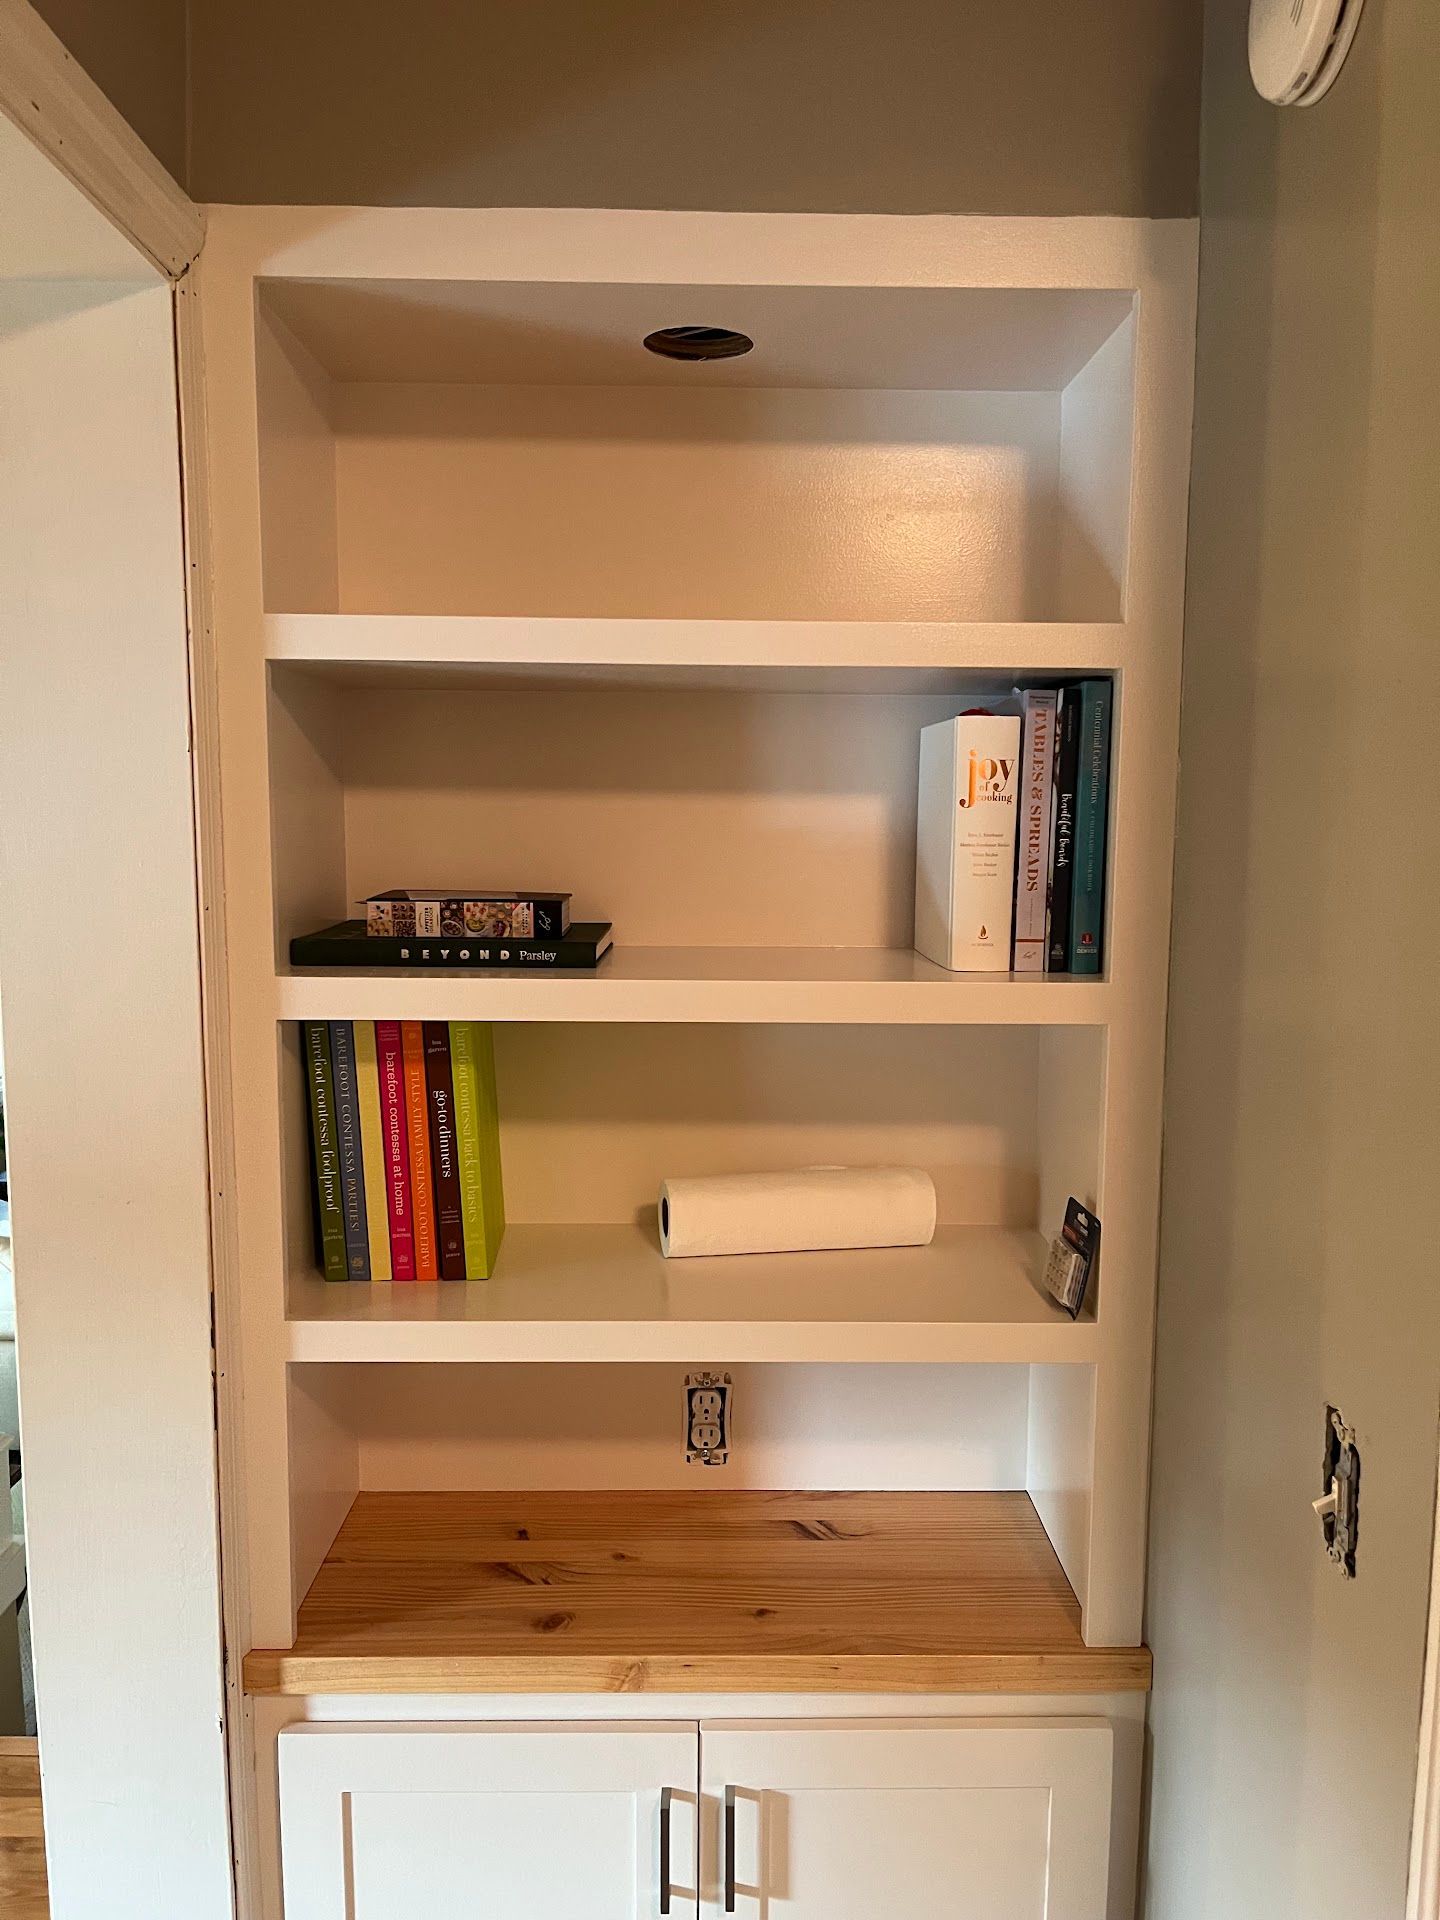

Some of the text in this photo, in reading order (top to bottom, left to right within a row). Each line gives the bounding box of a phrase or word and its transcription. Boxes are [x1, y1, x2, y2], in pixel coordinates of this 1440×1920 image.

[1032, 708, 1049, 783] TABLES
[1092, 700, 1104, 749] Centennial
[959, 749, 1016, 809] joy
[977, 791, 1013, 805] cooking
[979, 781, 991, 791] of
[1031, 787, 1043, 801] &
[1090, 749, 1102, 805] Celebrations
[1026, 804, 1042, 893] SPREADS
[1056, 793, 1072, 868] Beautiful Boards
[401, 949, 557, 963] BEYOND Parsley
[310, 1027, 327, 1084] barefoot
[335, 1028, 351, 1099] BAREFOOT
[385, 1052, 398, 1104] barefoot
[455, 1028, 469, 1082] barefoot
[410, 1070, 421, 1103] STYLE
[461, 1085, 473, 1137] contessa
[317, 1088, 330, 1147] contessa
[342, 1104, 355, 1174] CONTESSA
[389, 1107, 401, 1163] contessa
[412, 1105, 424, 1146] FAMILY
[433, 1090, 452, 1178] go-to dinners
[394, 1166, 402, 1179] at
[415, 1147, 427, 1206] CONTESSA
[465, 1139, 474, 1167] back
[467, 1169, 474, 1183] to
[319, 1150, 340, 1214] foolproof
[347, 1178, 360, 1233] PARTIES!
[394, 1182, 404, 1216] home
[468, 1185, 480, 1223] basics
[418, 1207, 430, 1268] BAREFOOT
